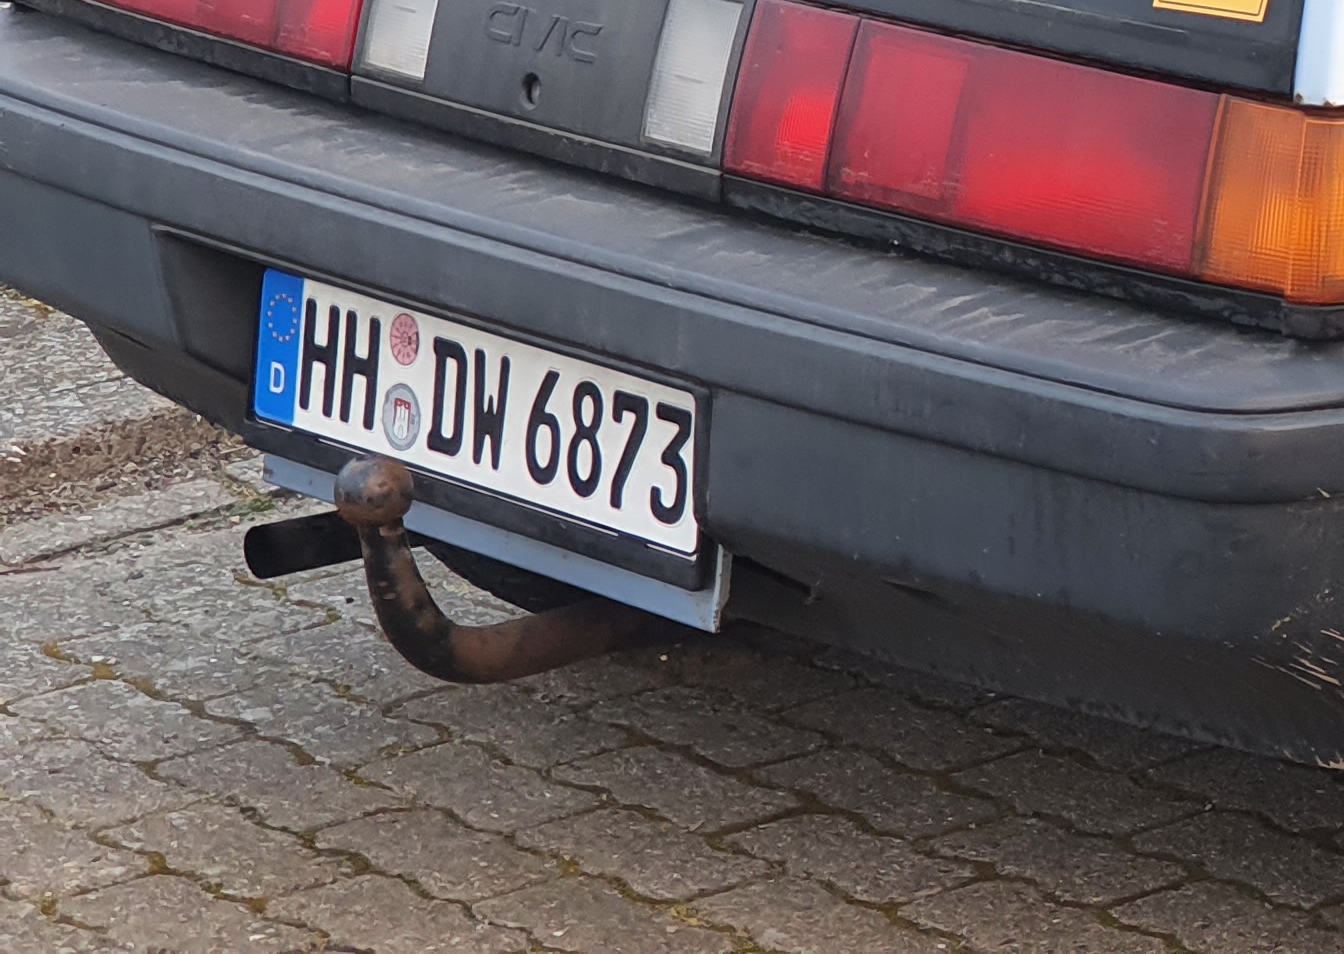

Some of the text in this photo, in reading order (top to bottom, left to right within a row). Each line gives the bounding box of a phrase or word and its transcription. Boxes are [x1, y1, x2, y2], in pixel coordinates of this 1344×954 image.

[268, 360, 286, 394] D
[299, 297, 693, 525] HH DW 6873
